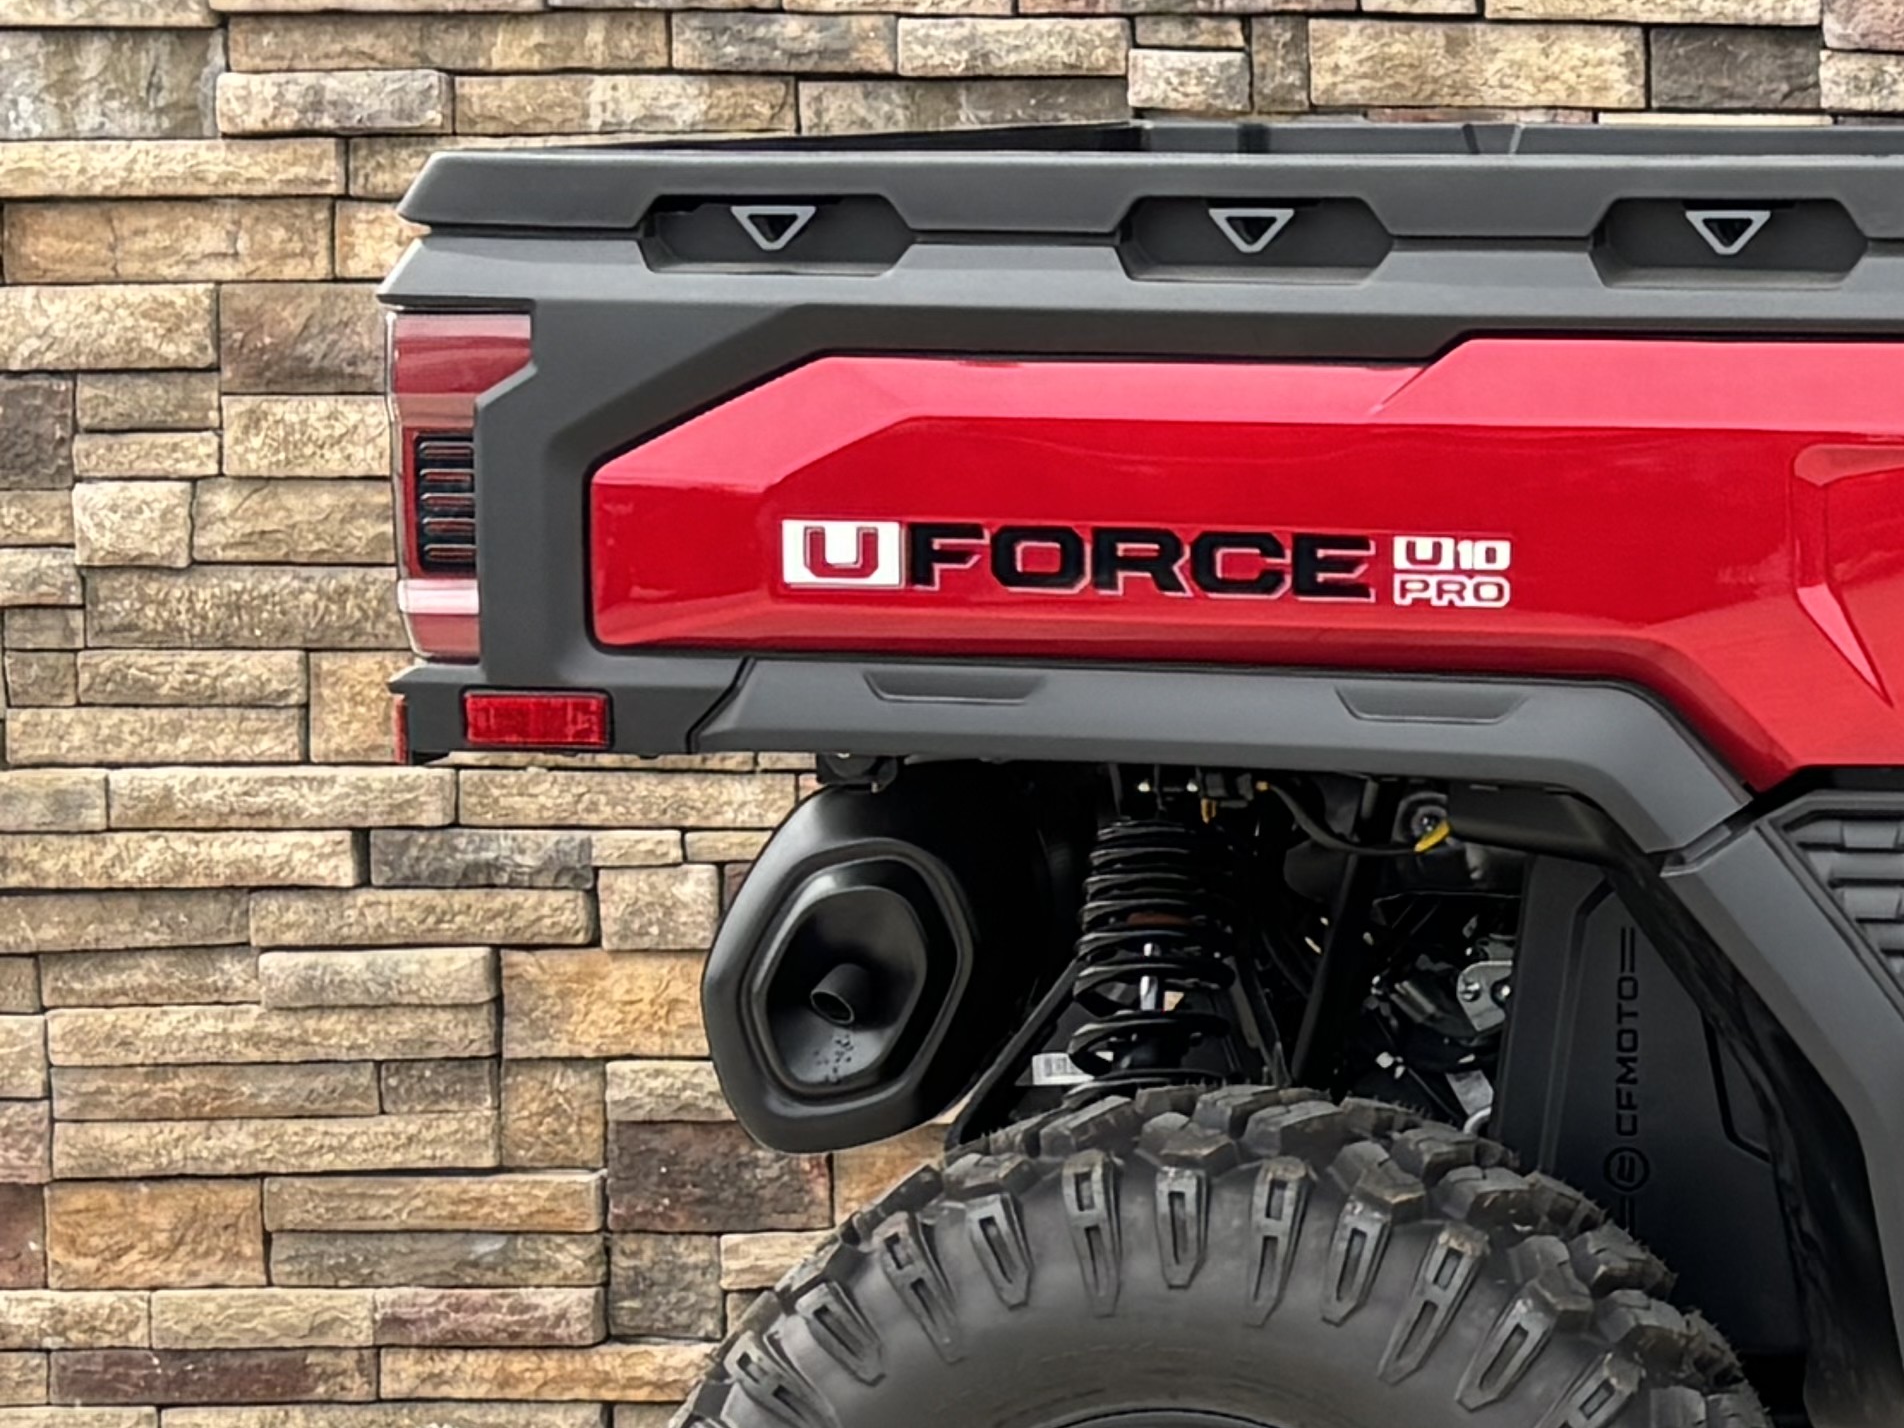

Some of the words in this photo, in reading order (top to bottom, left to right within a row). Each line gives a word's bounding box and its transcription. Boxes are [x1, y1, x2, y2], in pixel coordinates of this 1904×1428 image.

[1394, 535, 1511, 571] U10
[1394, 575, 1511, 608] PRO
[1615, 974, 1640, 1138] CFMOTO
